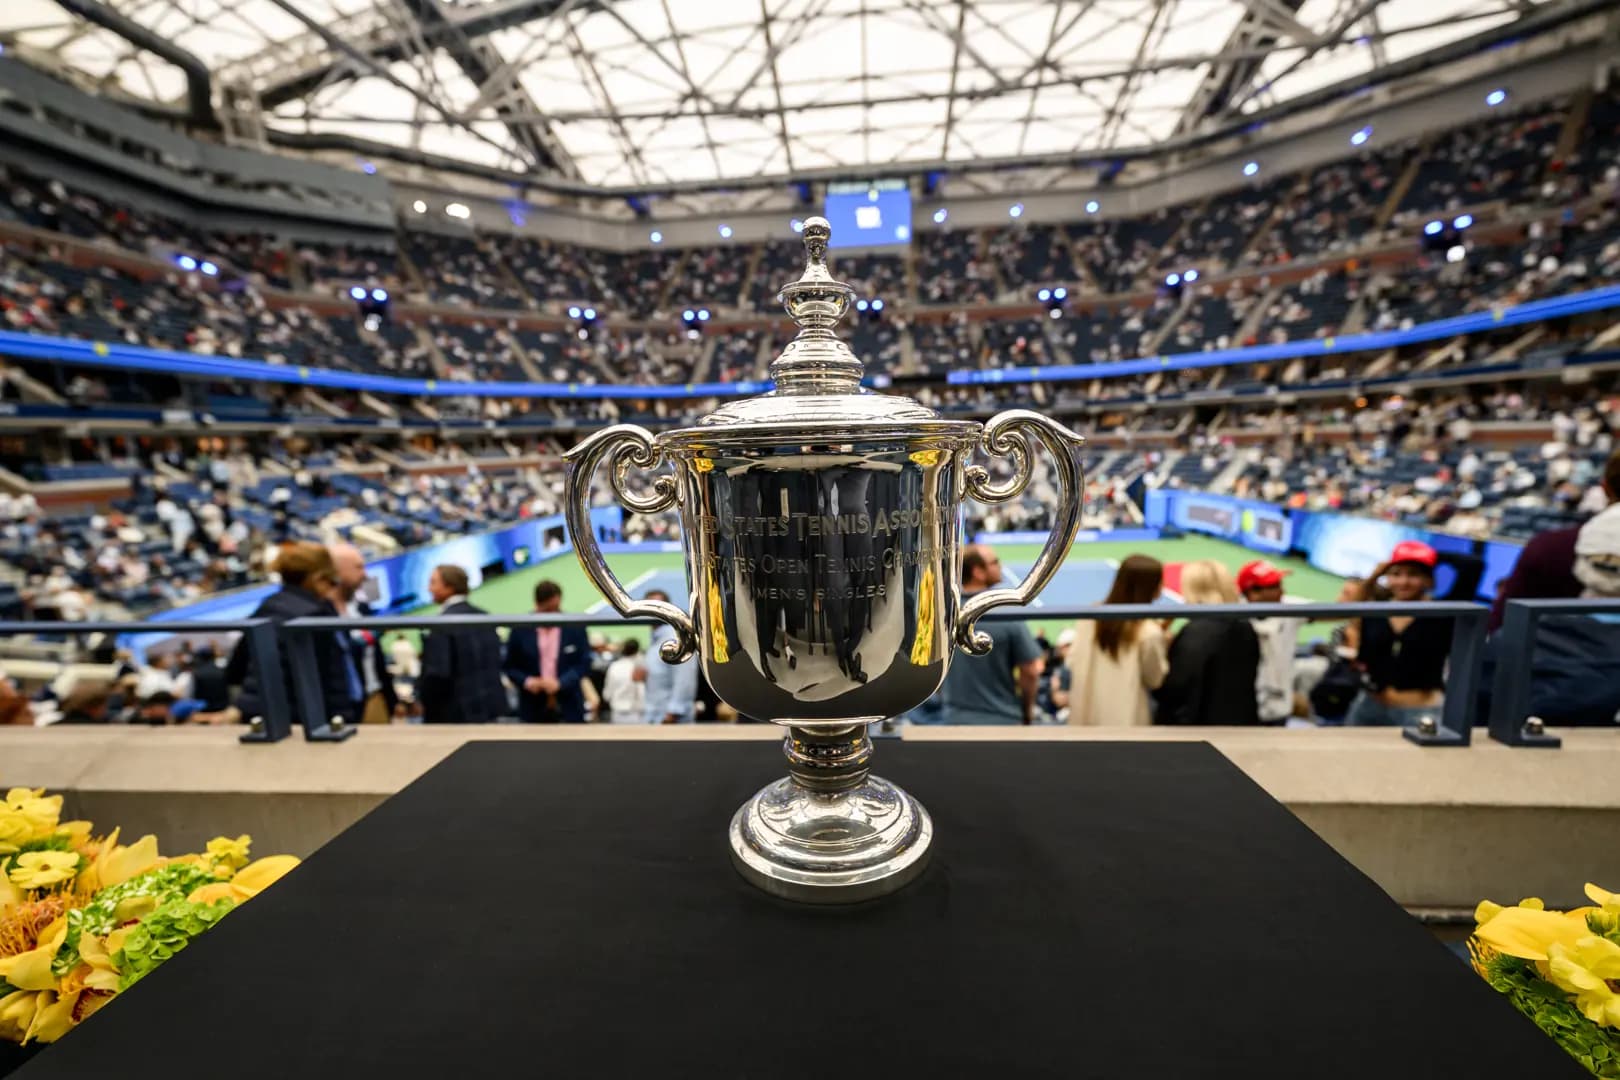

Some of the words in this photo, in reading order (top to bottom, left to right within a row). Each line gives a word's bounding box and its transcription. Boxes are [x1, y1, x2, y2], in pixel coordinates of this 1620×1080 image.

[720, 502, 789, 540] STATES
[791, 512, 869, 542] TENNIS
[760, 553, 809, 575] OPEN
[813, 553, 876, 575] TENNIS
[756, 587, 807, 601] MEN'S
[814, 583, 888, 601] SINGLES
